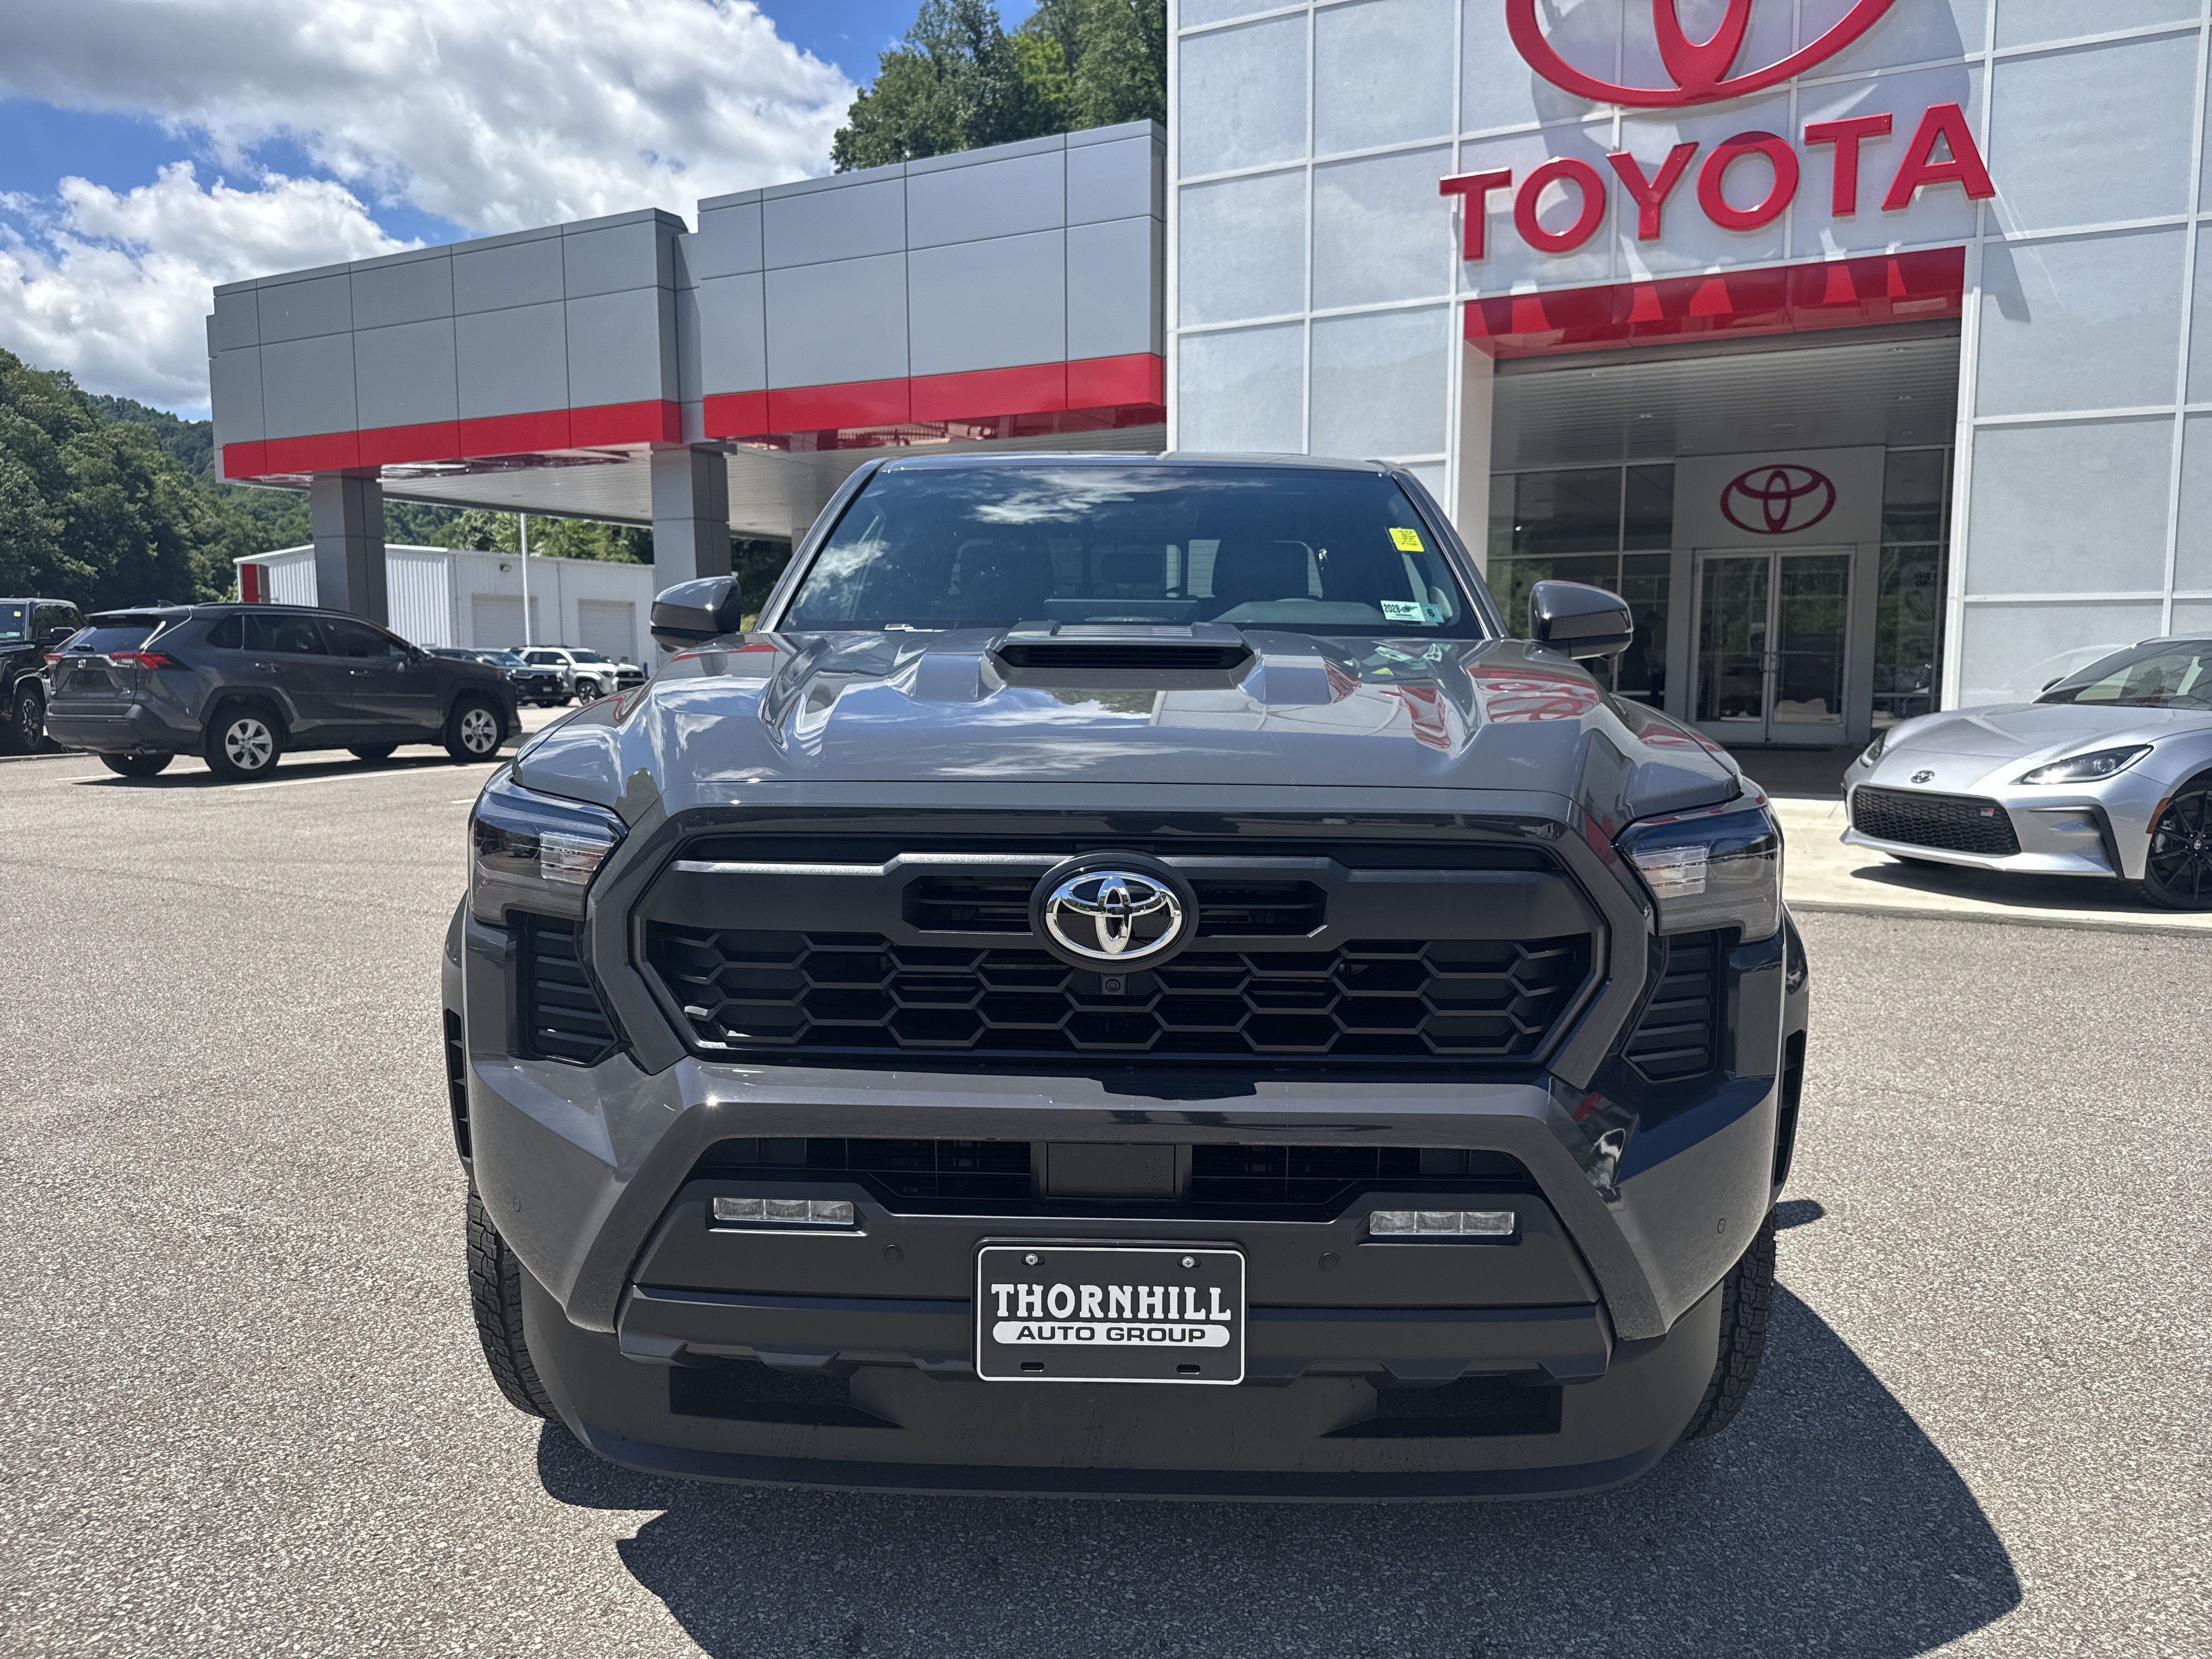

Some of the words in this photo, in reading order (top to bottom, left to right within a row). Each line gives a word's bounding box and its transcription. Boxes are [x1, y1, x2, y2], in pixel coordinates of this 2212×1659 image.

[1440, 102, 1996, 261] TOYOTA
[991, 1283, 1231, 1321] THORNHILL
[1015, 1325, 1095, 1341] AUTO
[1106, 1327, 1206, 1343] GROUP
